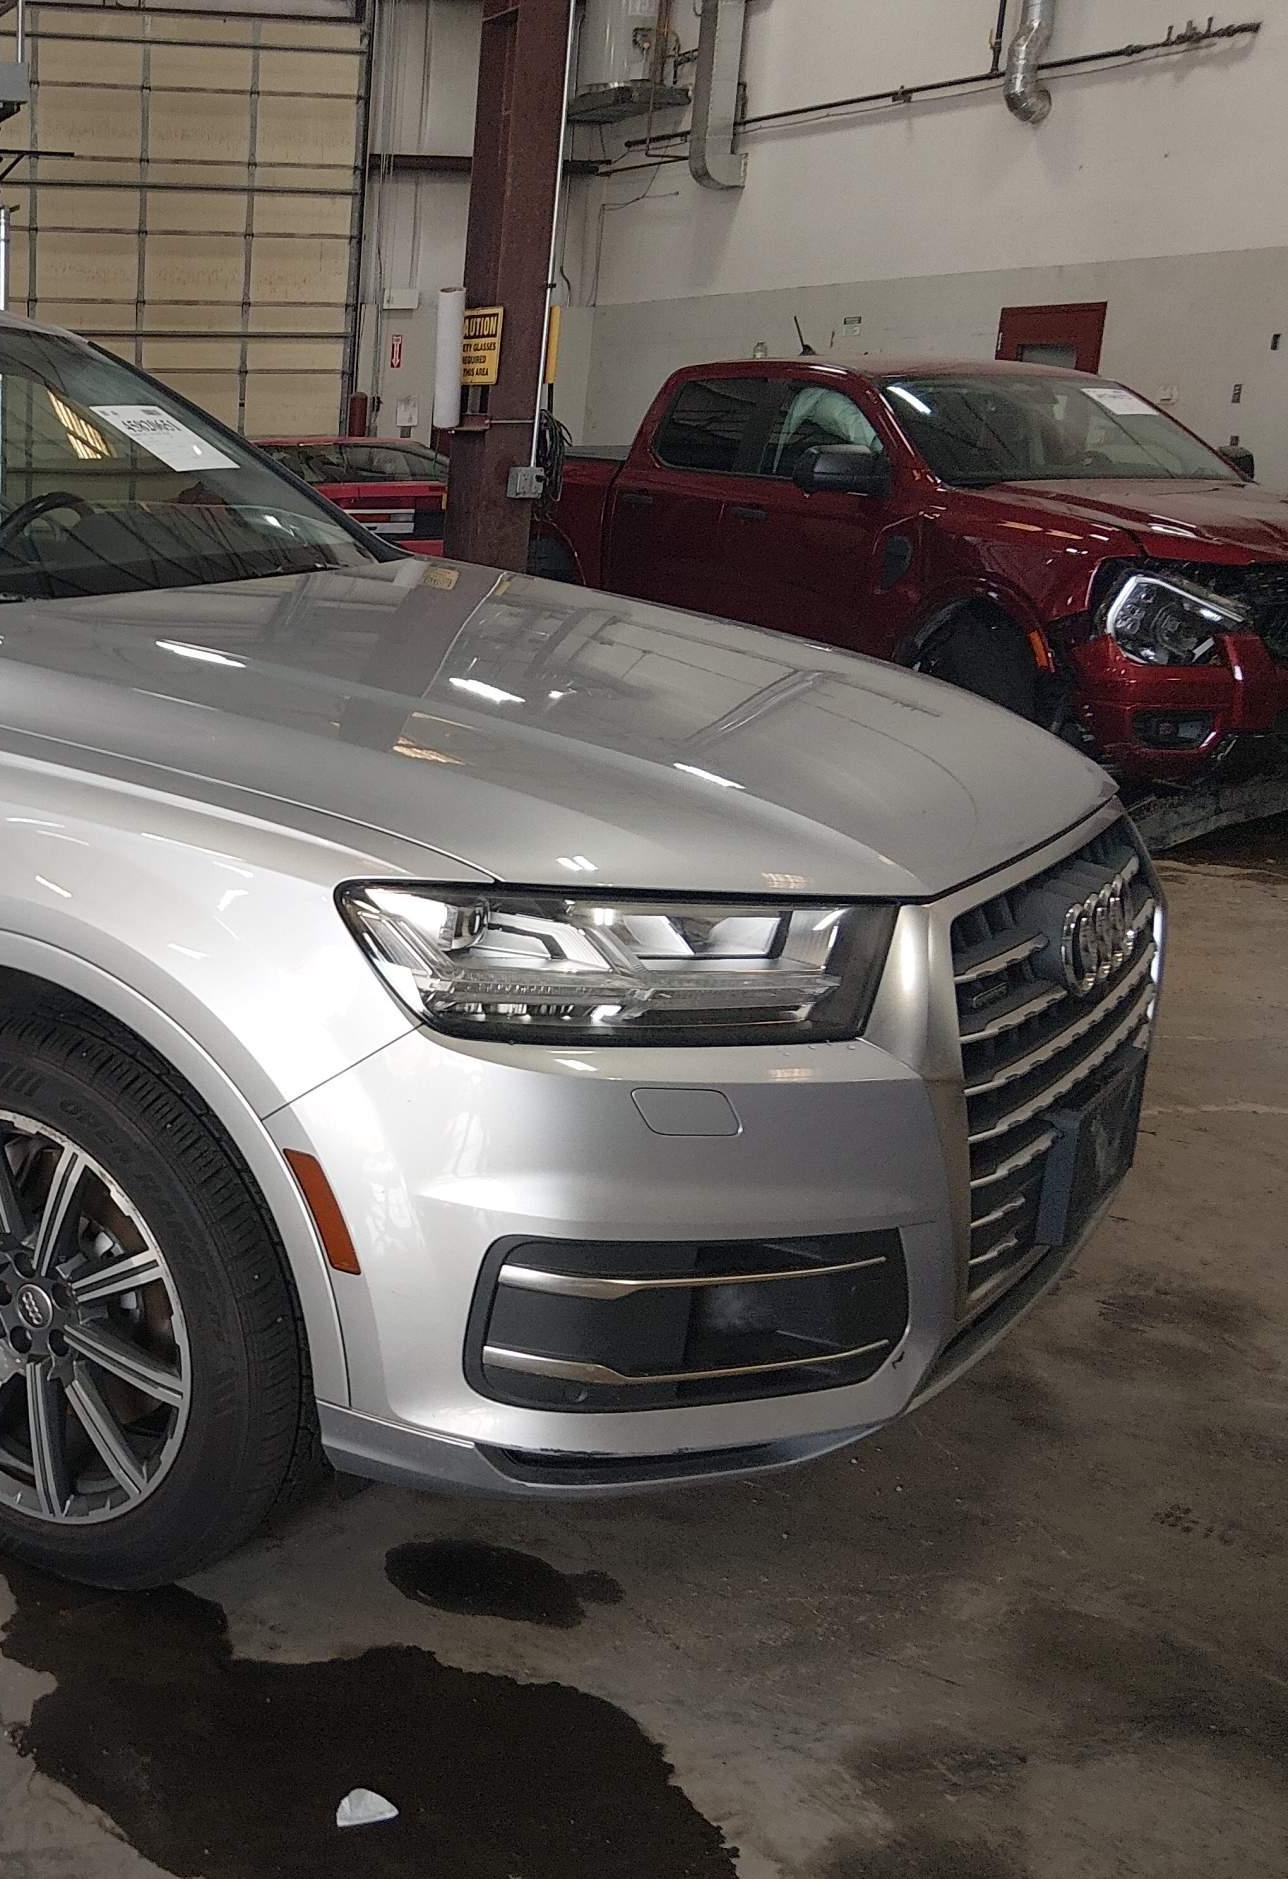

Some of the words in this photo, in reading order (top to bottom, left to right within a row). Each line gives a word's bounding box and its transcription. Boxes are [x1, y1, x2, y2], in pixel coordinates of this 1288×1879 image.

[463, 316, 498, 337] AUTION
[473, 341, 496, 352] GLASSES
[475, 367, 489, 376] AREA
